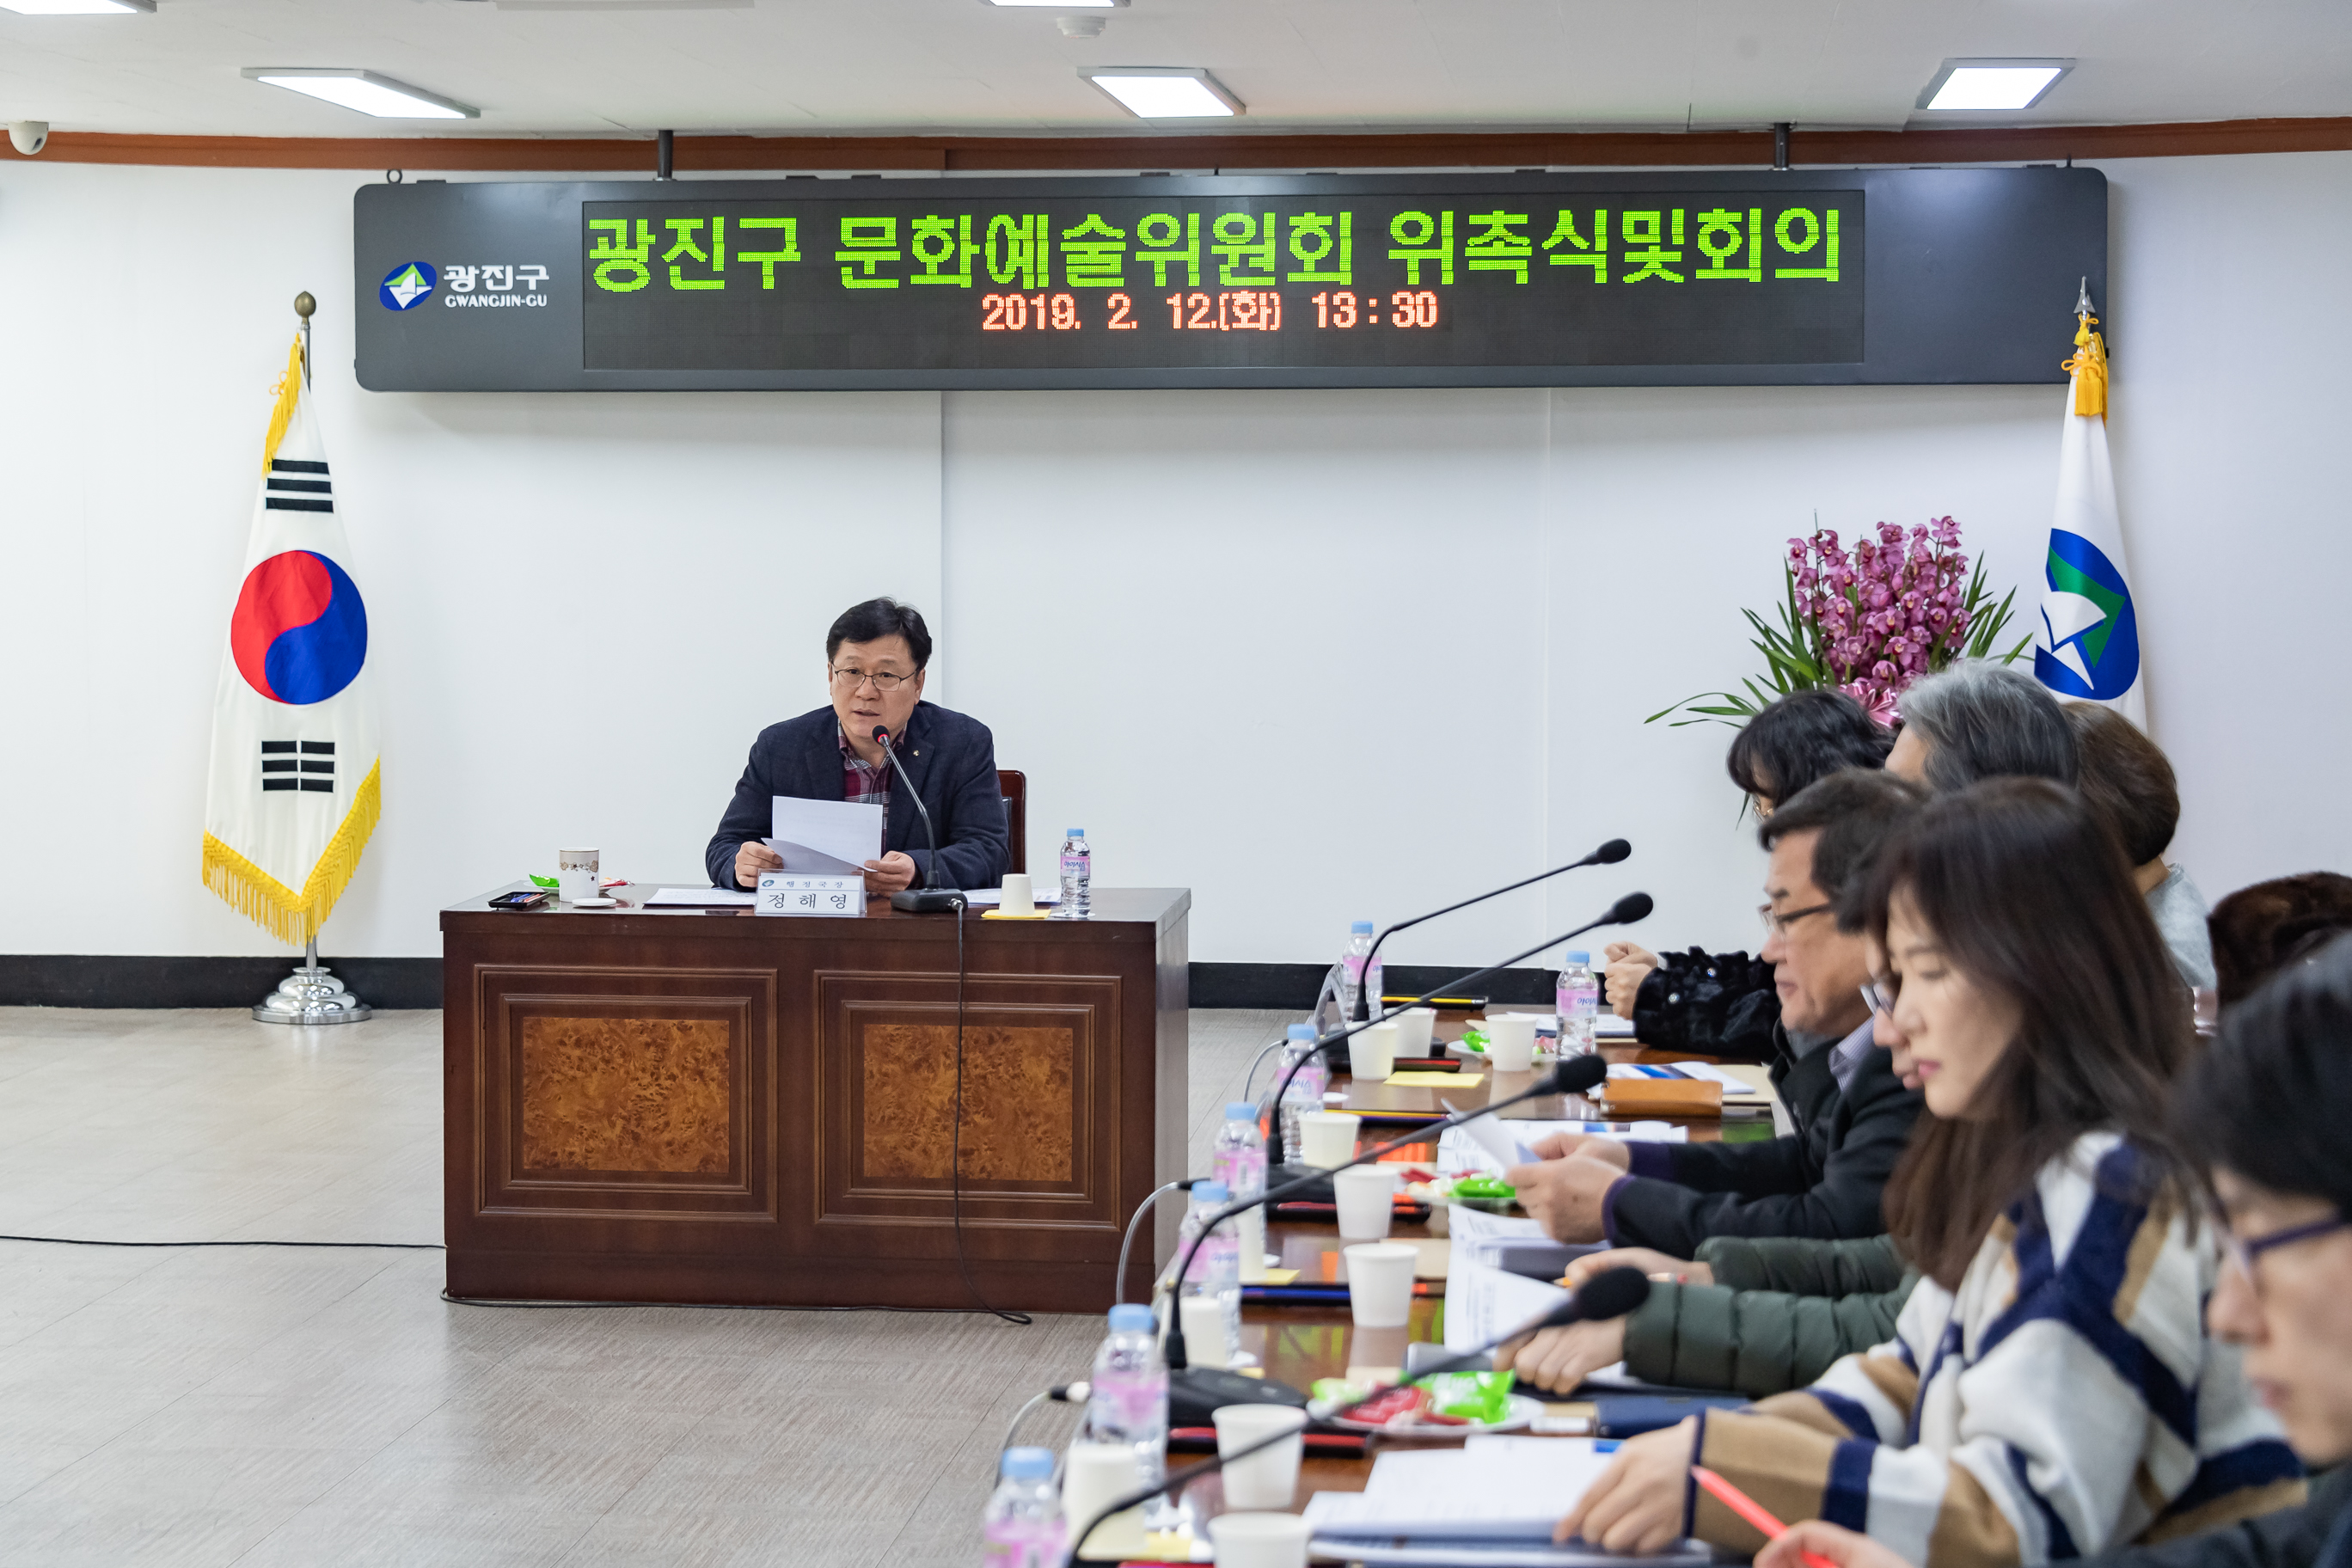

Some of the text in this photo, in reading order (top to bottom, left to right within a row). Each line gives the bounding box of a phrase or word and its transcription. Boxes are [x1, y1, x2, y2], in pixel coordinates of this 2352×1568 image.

[589, 207, 1840, 293] 광진구 문화예술위원회 위촉식및회의
[443, 264, 550, 293] 광진구
[444, 293, 548, 308] GWANGJIN-GU
[982, 293, 1081, 330] 2019.
[1107, 292, 1138, 330] 2.
